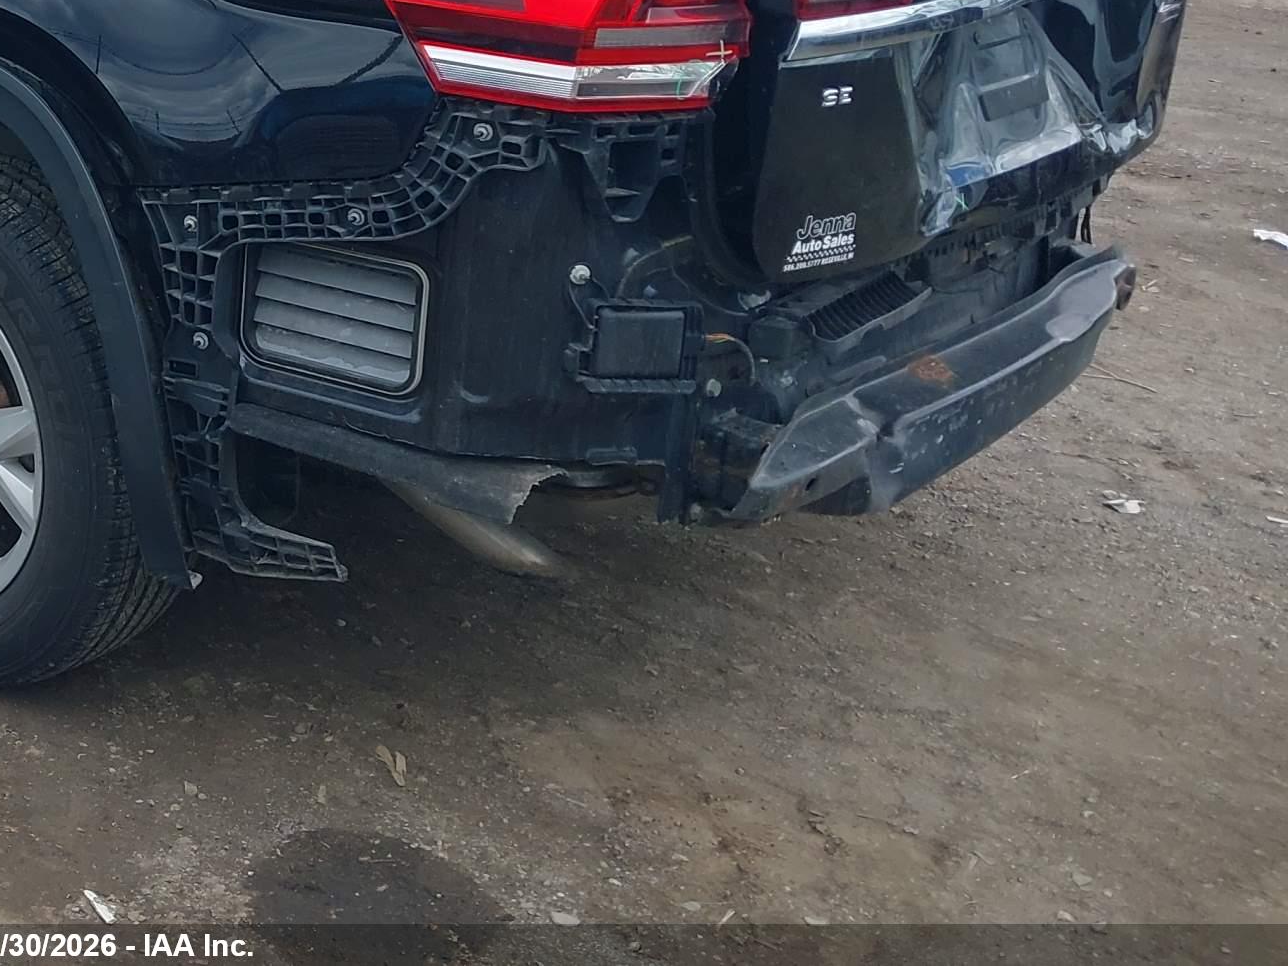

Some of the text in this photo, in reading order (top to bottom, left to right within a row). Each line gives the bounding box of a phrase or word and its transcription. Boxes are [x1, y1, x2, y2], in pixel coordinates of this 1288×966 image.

[822, 86, 853, 108] SE
[796, 212, 857, 240] Jenna
[791, 233, 855, 255] Auto Sales
